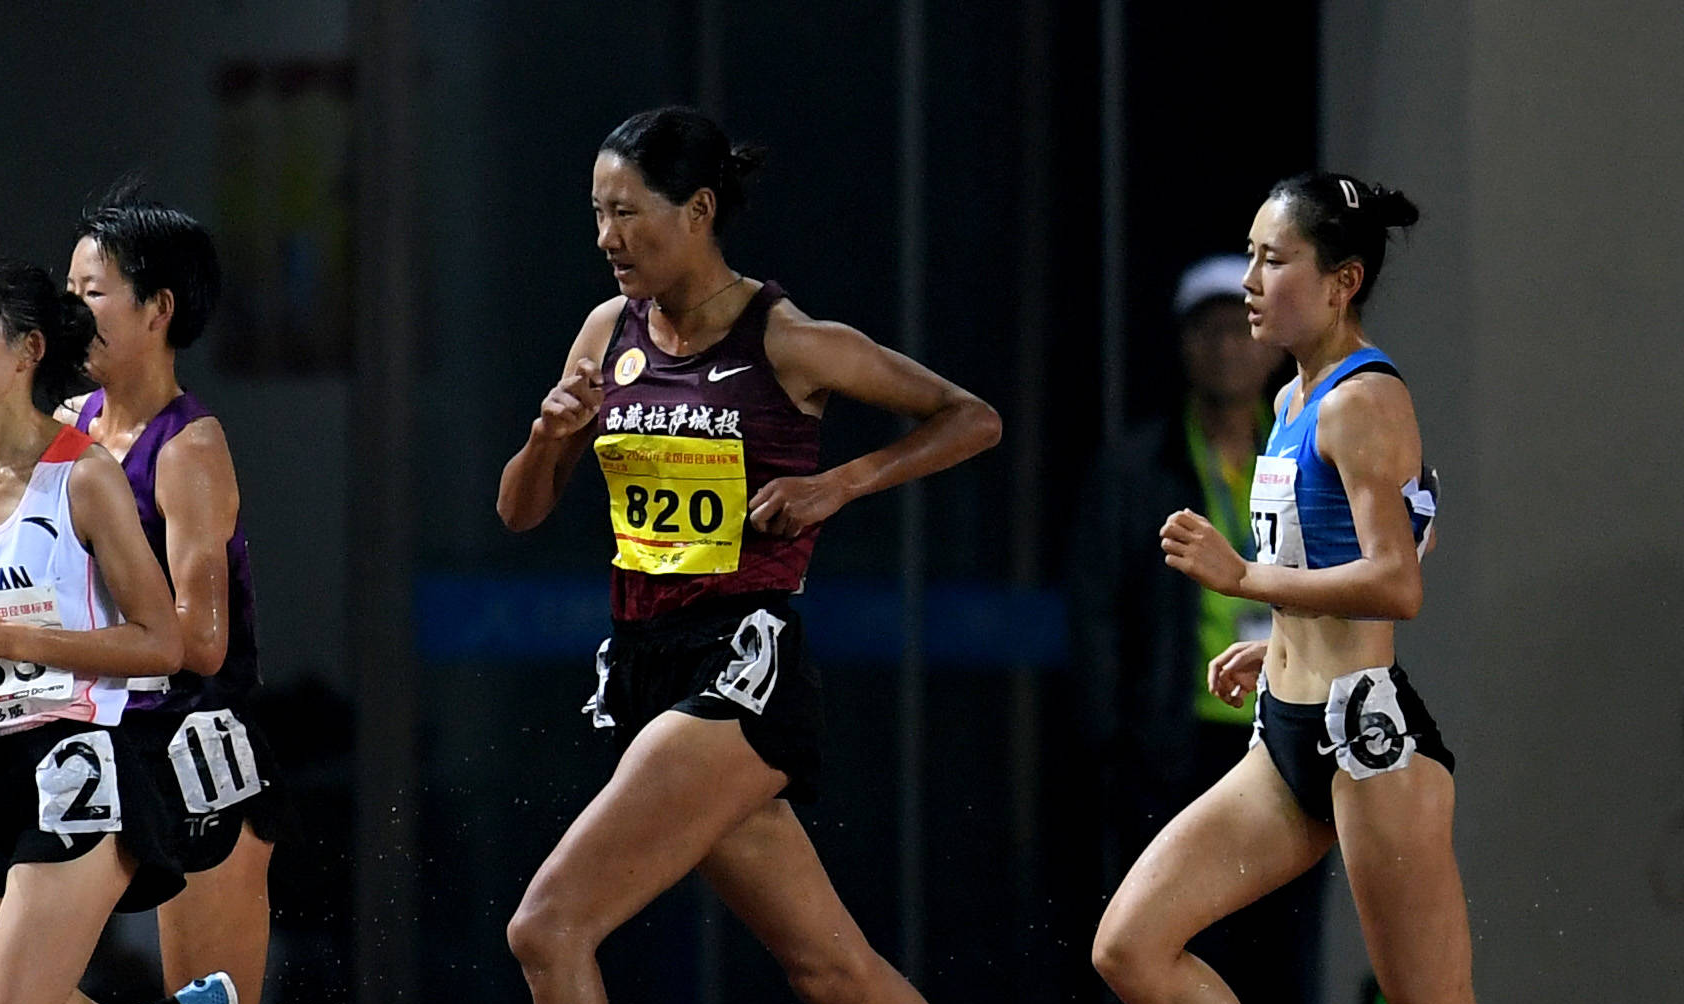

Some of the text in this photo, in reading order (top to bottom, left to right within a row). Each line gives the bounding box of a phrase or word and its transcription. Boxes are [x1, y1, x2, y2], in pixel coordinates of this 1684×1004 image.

[606, 402, 743, 438] 西藏拉萨城投
[625, 484, 724, 534] 820
[184, 716, 246, 803] 11
[1344, 673, 1405, 770] 6
[54, 741, 112, 822] 2
